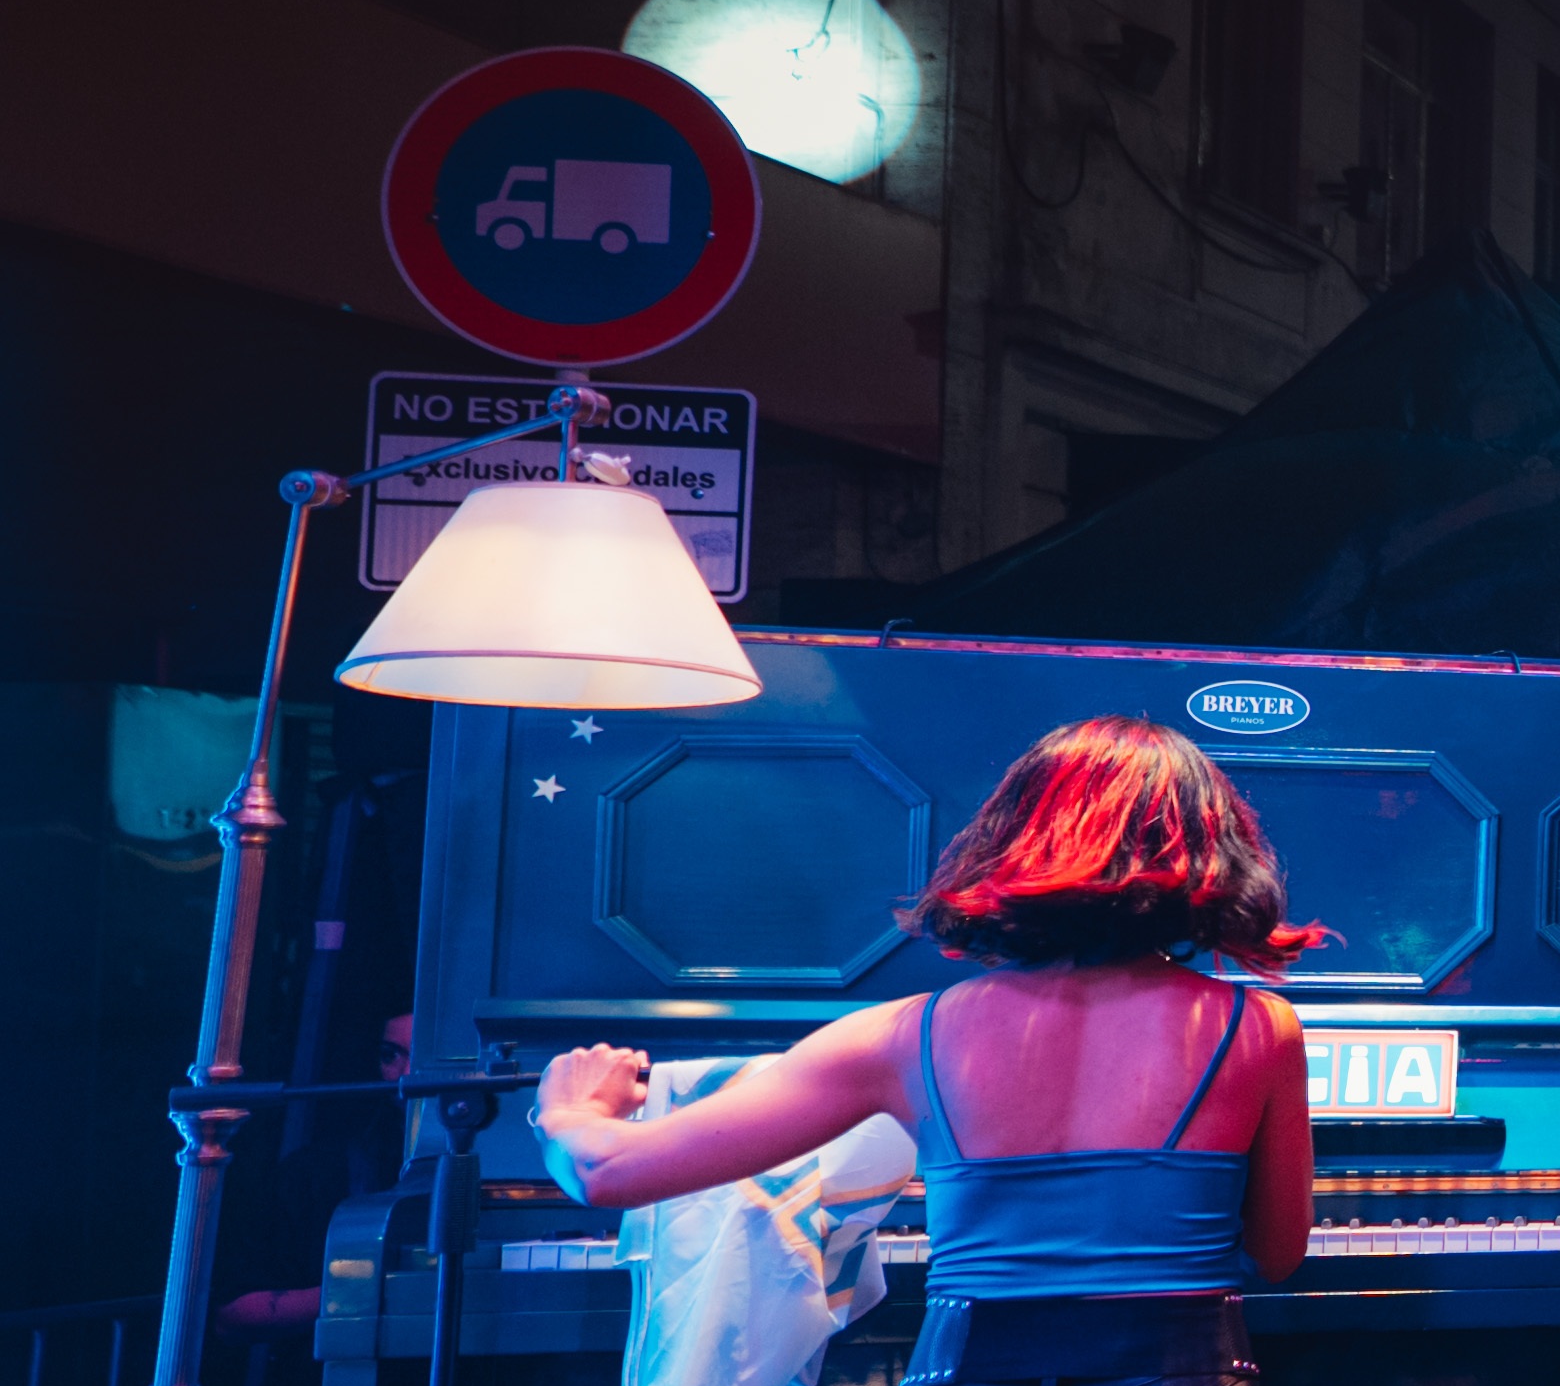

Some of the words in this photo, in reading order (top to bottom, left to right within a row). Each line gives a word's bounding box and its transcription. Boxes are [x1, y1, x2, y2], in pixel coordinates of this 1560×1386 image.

[394, 393, 453, 422] NO
[467, 397, 728, 434] ESTIONAR
[1202, 694, 1294, 716] BREYER
[1230, 716, 1264, 725] PIANOS
